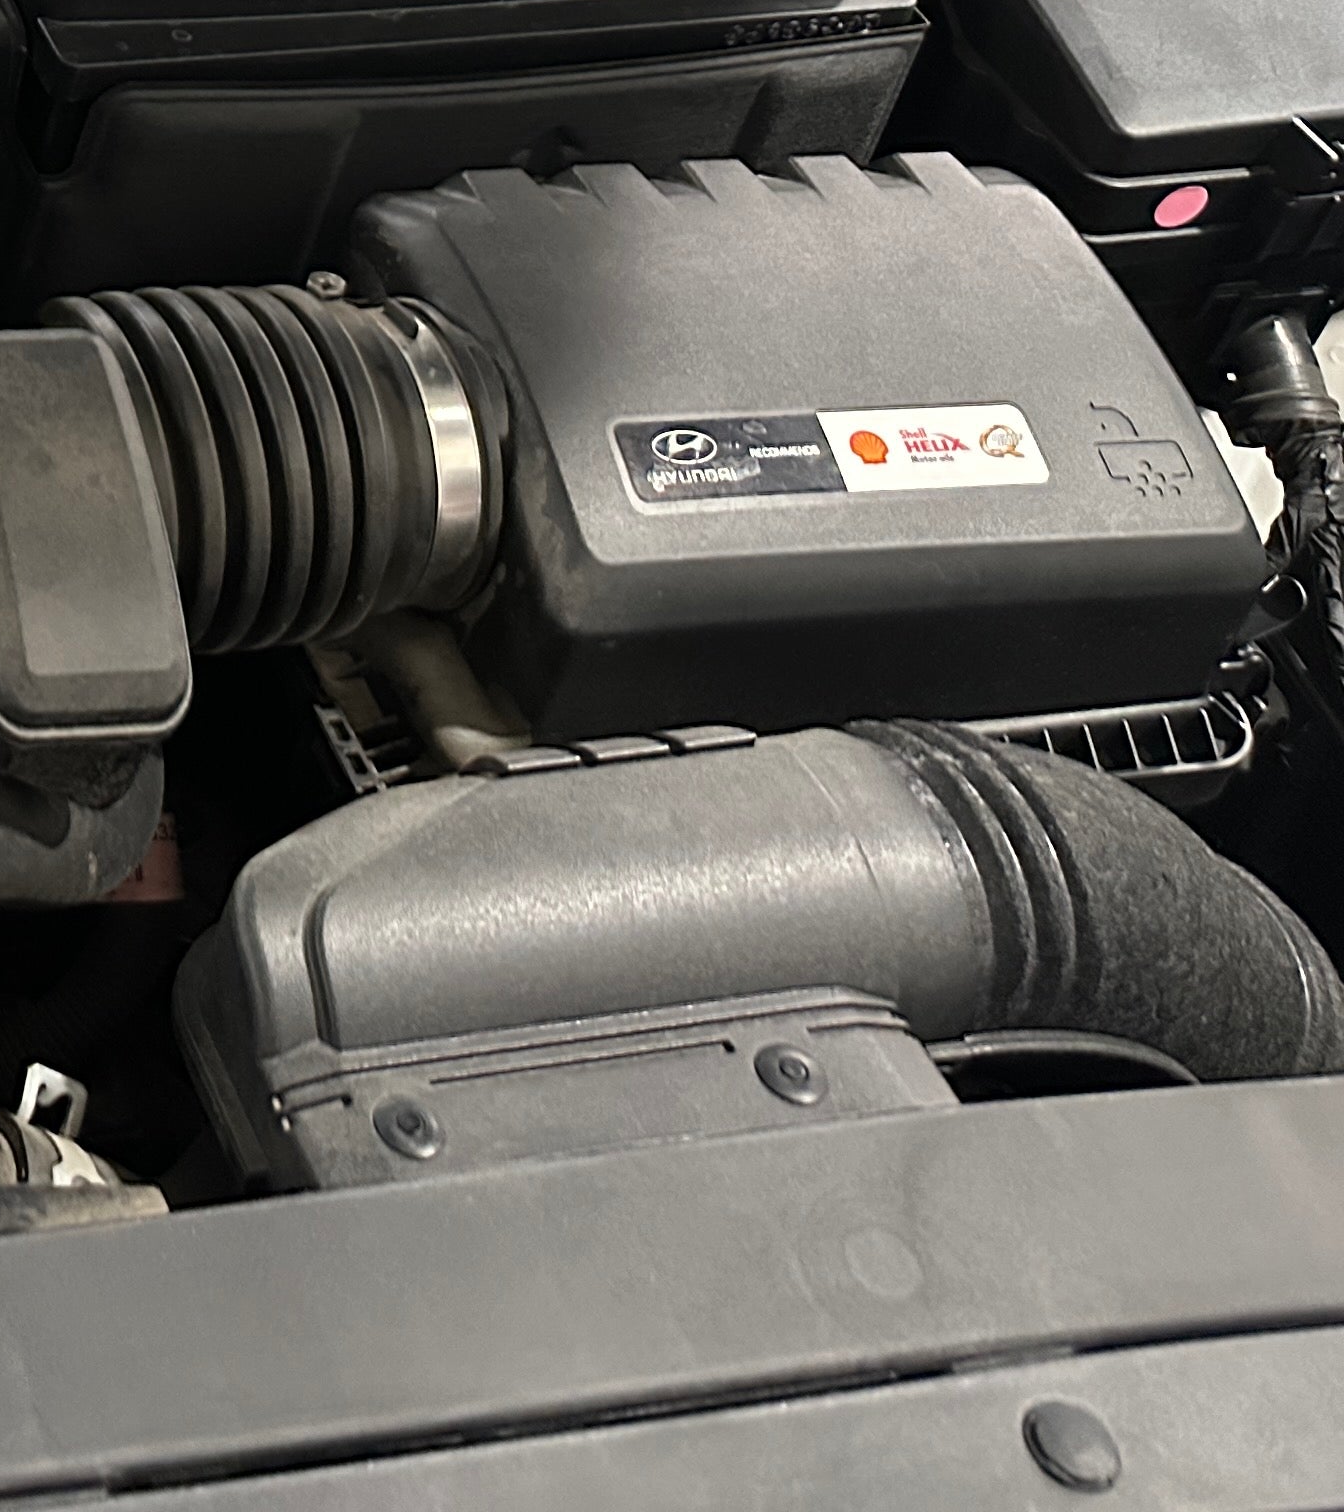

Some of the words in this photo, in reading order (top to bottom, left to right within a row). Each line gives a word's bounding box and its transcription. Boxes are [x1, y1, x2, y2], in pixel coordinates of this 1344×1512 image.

[898, 428, 927, 439] Shell
[903, 438, 971, 454] HELIX
[652, 466, 739, 487] HYUNDAI
